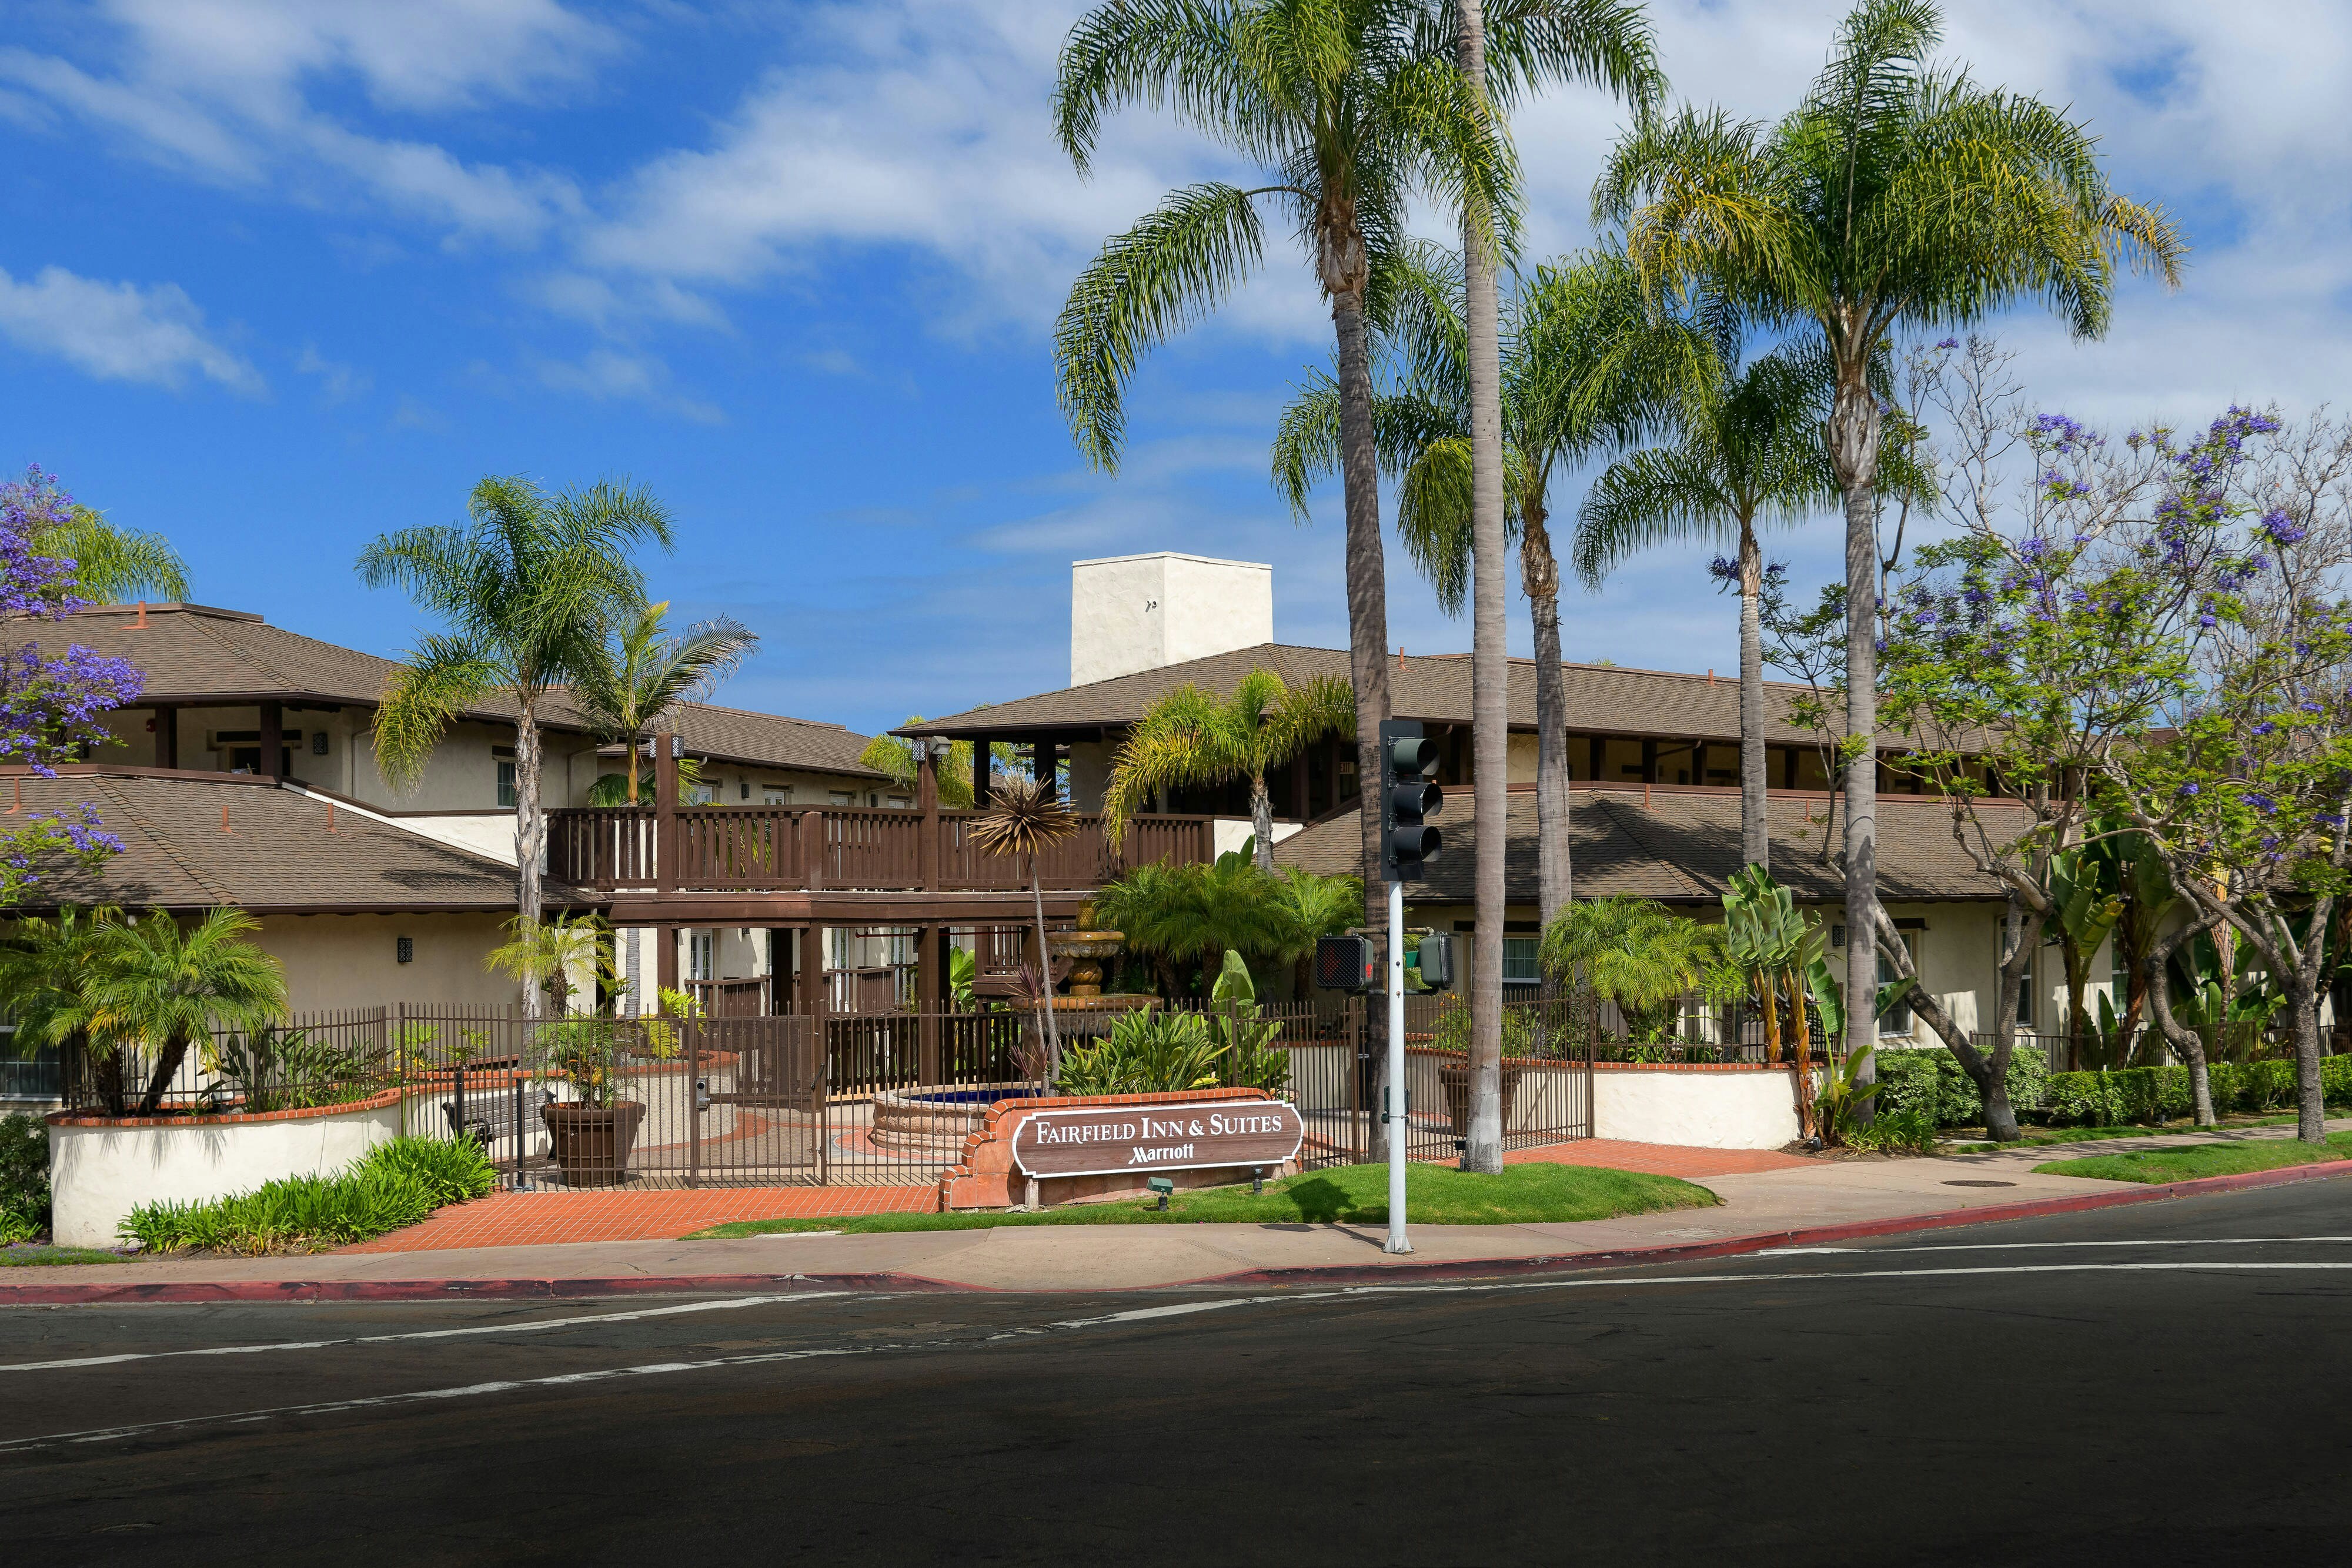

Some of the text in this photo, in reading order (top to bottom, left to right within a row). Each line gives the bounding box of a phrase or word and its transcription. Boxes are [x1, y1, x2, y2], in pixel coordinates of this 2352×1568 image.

[1339, 762, 1351, 773] EXIT
[1035, 1113, 1283, 1144] FAIRFIELD INN & SUITES
[1128, 1143, 1194, 1165] Marriott
